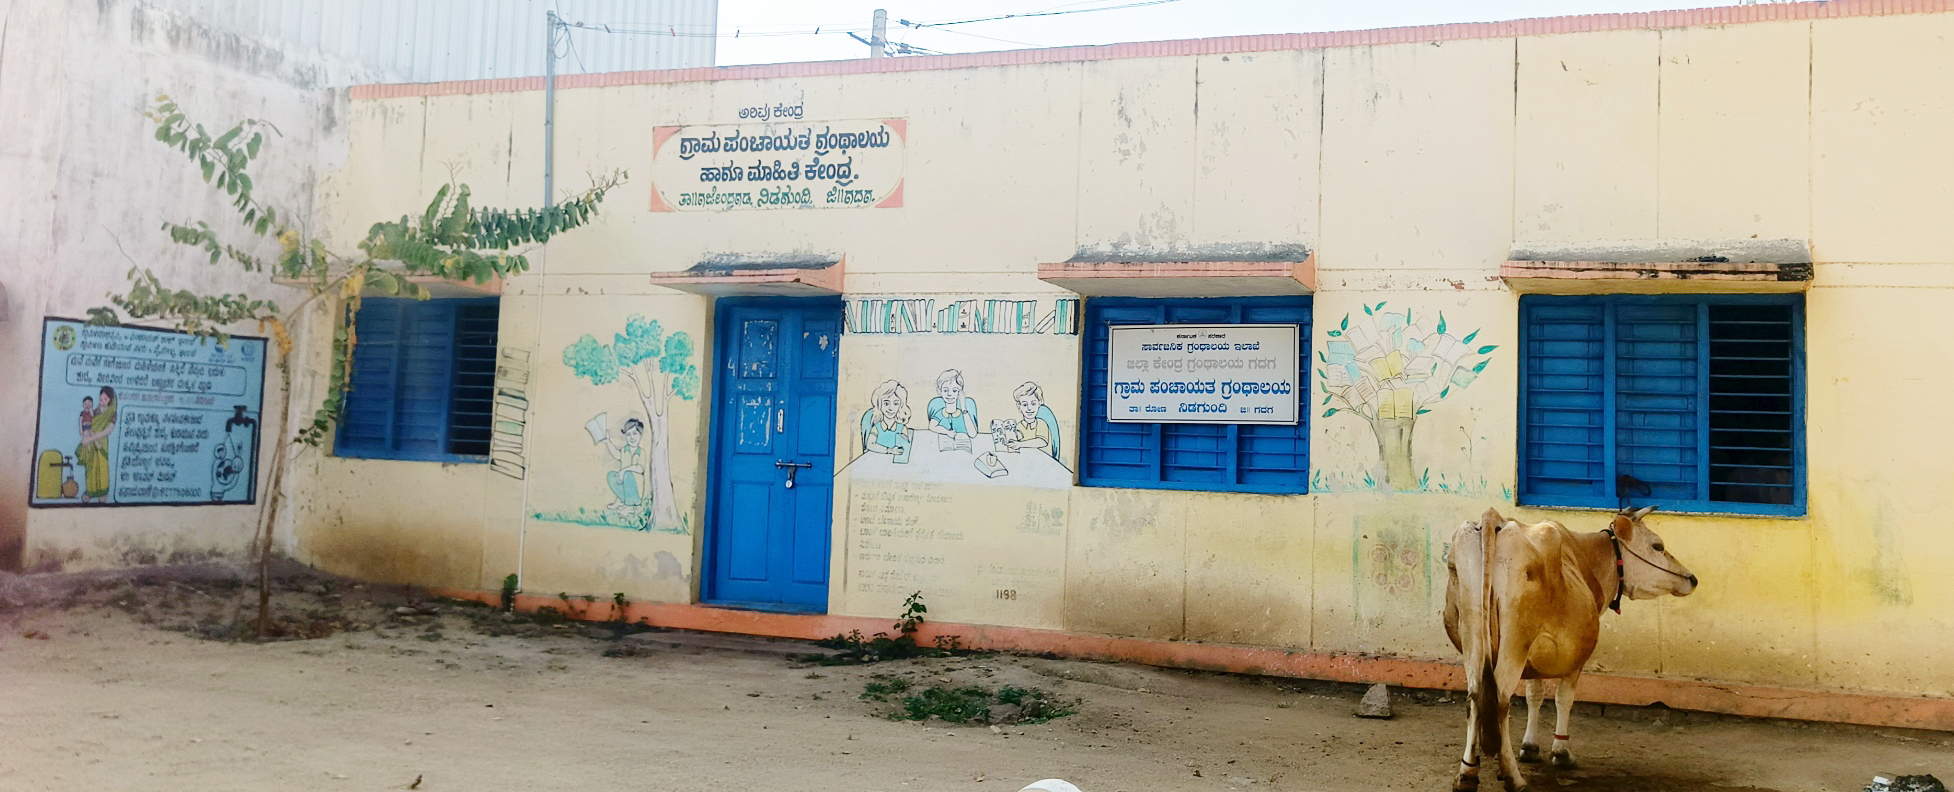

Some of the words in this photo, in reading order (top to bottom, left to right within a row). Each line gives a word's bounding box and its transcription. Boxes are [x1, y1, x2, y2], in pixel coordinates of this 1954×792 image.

[738, 103, 771, 121] ಅರಿವು
[773, 102, 804, 120] ಕೇಂದ್ರ
[679, 131, 721, 161] ಗ್ರಾಮ
[724, 128, 812, 154] ಪಂಚಾಯತ
[815, 125, 890, 156] ಗ್ರಂಥಾಲಯ
[699, 162, 744, 183] ಹಾಗೂ
[747, 158, 799, 182] ಮಾಹಿತಿ
[804, 156, 859, 187] ಕೇಂದ್ರ.
[1141, 342, 1183, 351] ಸಾರ್ವಜನಿಕ
[1187, 342, 1230, 354] ಗ್ರಂಥಾಲಯ
[1234, 341, 1260, 351] ಇಲಾಖೆ
[1153, 356, 1183, 372] ಕೇಂದ್ರ
[1187, 357, 1244, 373] ಗ್ರಂಥಾಲಯ
[1248, 356, 1277, 370] ಗದಗ
[1114, 378, 1145, 399] ಗ್ರಾಮ
[1149, 378, 1216, 395] ಪಂಚಾಯತ
[1221, 378, 1291, 400] ಗ್ರಂಥಾಲಯ
[1145, 405, 1167, 413] ರೋಣ
[1178, 401, 1228, 414] ನಿಡಗುಂದಿ
[1254, 406, 1274, 414] ಗದಗ
